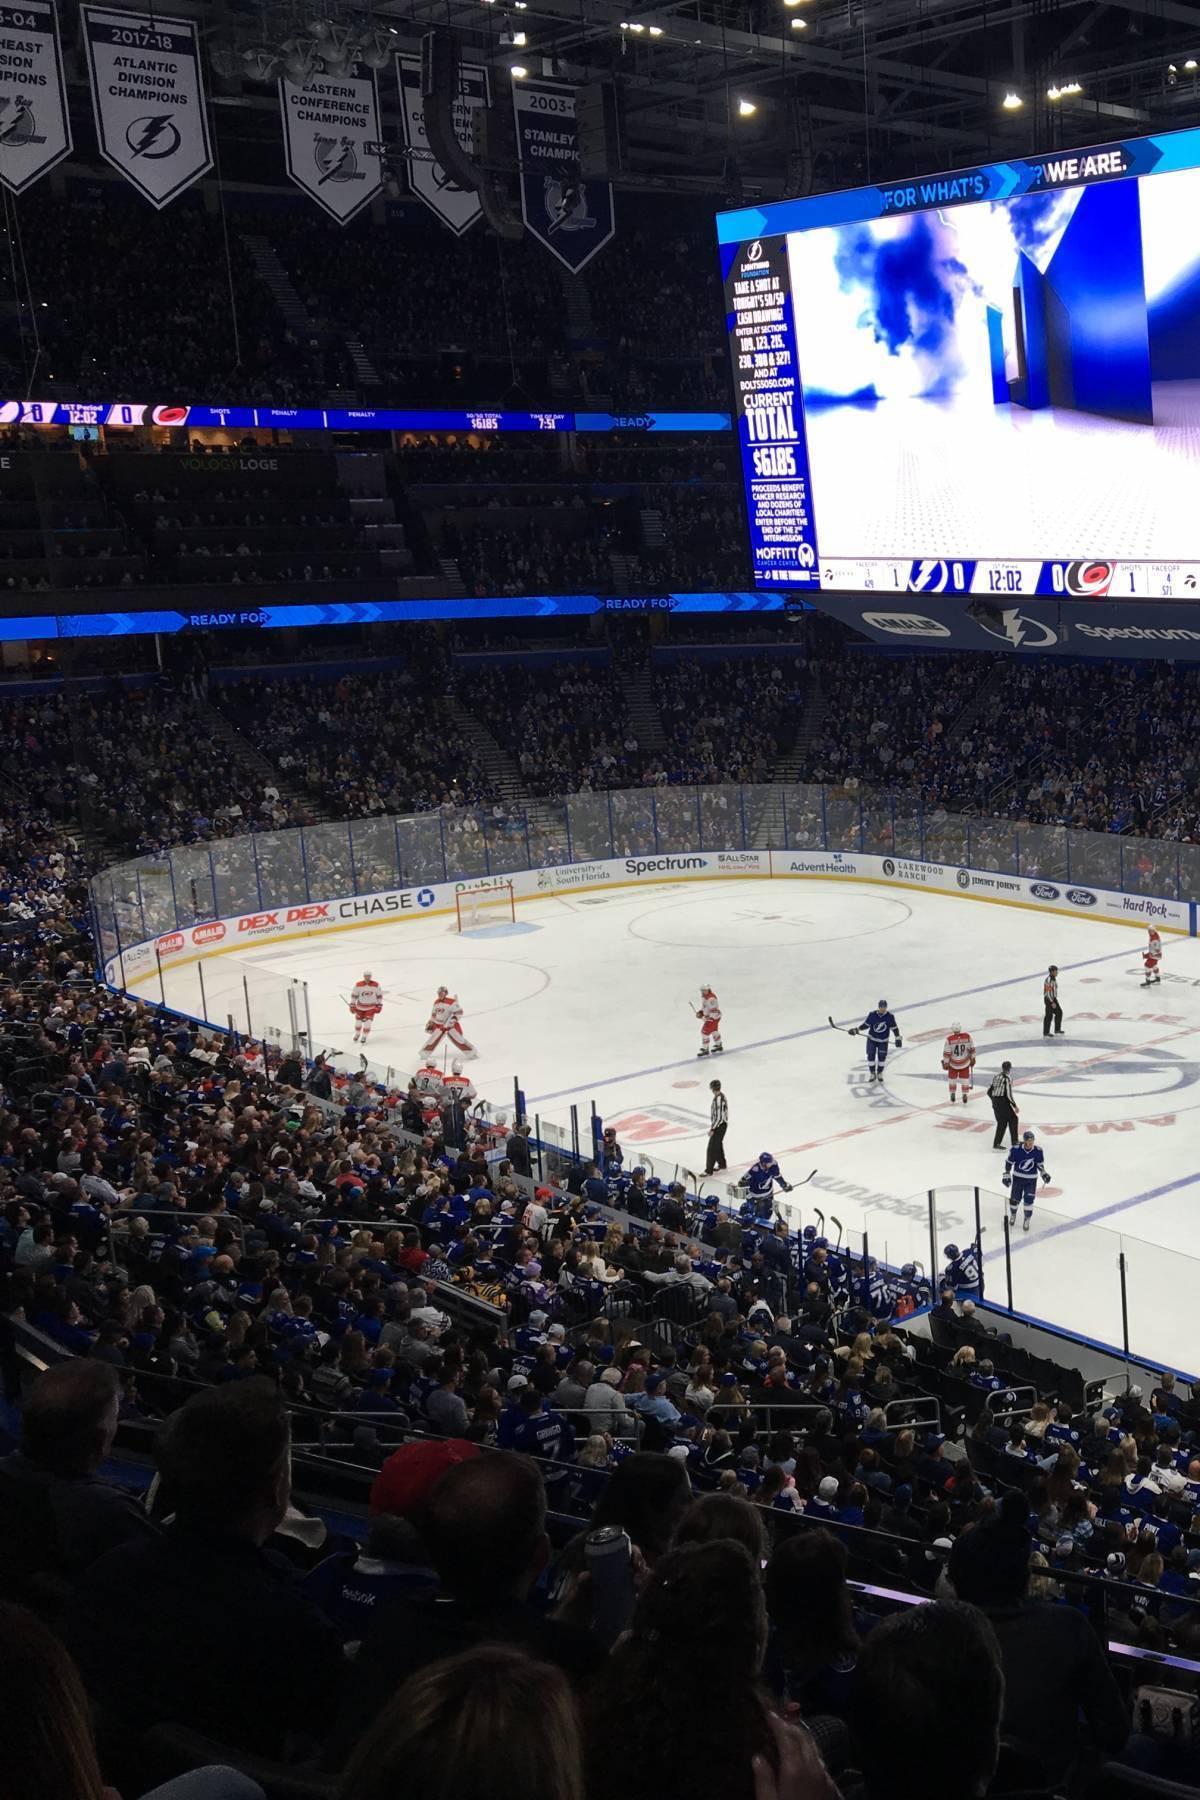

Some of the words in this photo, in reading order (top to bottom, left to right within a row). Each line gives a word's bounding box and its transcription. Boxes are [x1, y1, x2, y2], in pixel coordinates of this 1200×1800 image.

[111, 29, 173, 50] 2017-18
[113, 56, 178, 74] ATLANTIC
[118, 71, 176, 89] DIVISION
[108, 85, 189, 105] CHAMPIONS
[290, 95, 370, 115] CONFERENCE
[297, 110, 367, 128] CHAMPIONS
[1048, 161, 1079, 183] WE
[1083, 150, 1128, 177] ARE.
[884, 191, 917, 210] FOR
[921, 175, 985, 202] WHAT'S
[754, 368, 769, 379] AND
[770, 367, 778, 377] AT
[743, 391, 794, 409] CURRENT
[68, 410, 99, 424] 12:02
[271, 409, 298, 417] PENALTY
[348, 411, 376, 419] PENALTY
[471, 418, 498, 430] $6185
[745, 405, 798, 441] TOTAL
[239, 458, 279, 471] LOGE
[753, 447, 796, 476] $6185
[756, 547, 797, 560] MOFFITT
[893, 567, 899, 588] 1
[989, 570, 1022, 591] 12:02
[1129, 571, 1136, 593] 1
[605, 598, 649, 609] READY
[190, 613, 231, 627] READY
[625, 857, 703, 877] Spectrum
[790, 861, 857, 874] AdventHealth
[898, 863, 944, 875] LAKEWOOD
[556, 873, 579, 886] South
[581, 870, 610, 883] Florida
[898, 871, 927, 882] RANCH
[971, 876, 995, 889] JIMMY
[996, 880, 1021, 892] JOHN'S
[1034, 885, 1055, 900] Ford
[1070, 891, 1092, 906] Ford
[286, 904, 331, 923] DEX
[339, 893, 413, 919] CHASE
[1123, 897, 1145, 913] Hard
[1145, 901, 1168, 919] Rock
[238, 912, 279, 932] DEX
[248, 925, 285, 936] imaging
[297, 916, 335, 927] imaging
